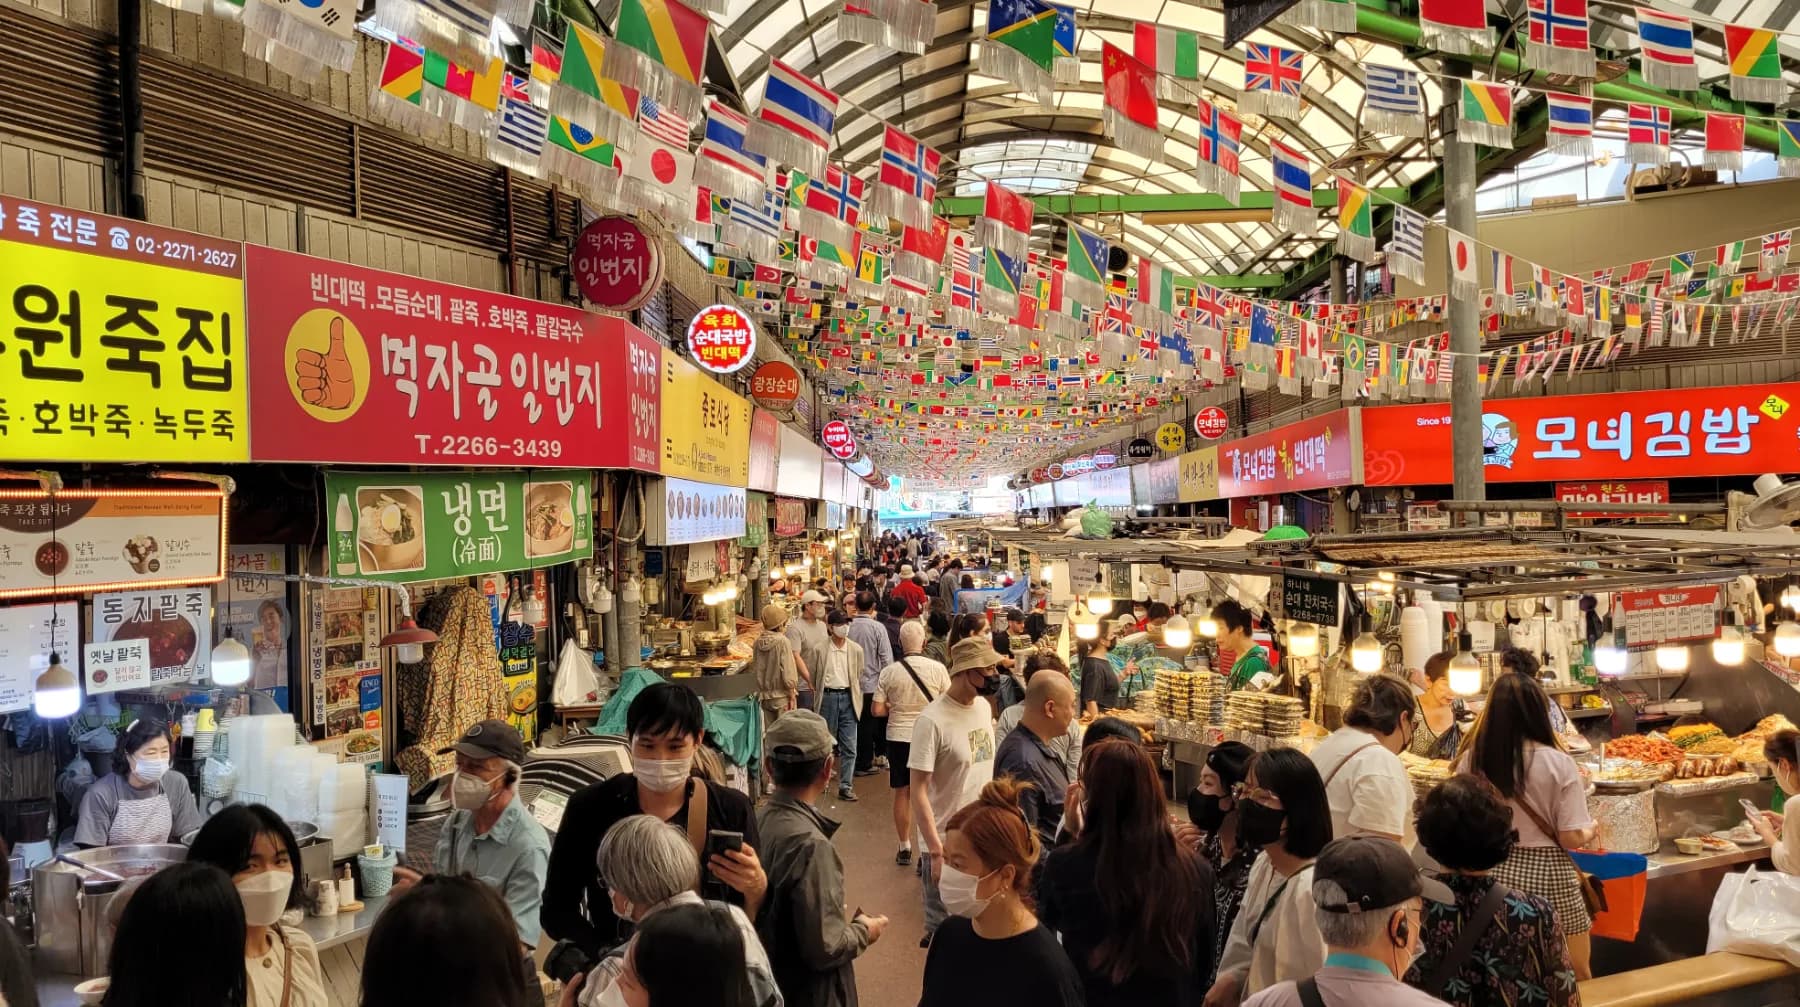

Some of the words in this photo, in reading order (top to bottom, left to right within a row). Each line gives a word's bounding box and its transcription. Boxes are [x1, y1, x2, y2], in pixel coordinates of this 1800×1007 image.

[16, 205, 41, 237] 죽
[50, 212, 98, 247] 전문
[587, 231, 638, 252] 먹자골
[578, 256, 643, 287] 일번지
[702, 313, 738, 327] 육회
[0, 283, 233, 393] 원죽집
[695, 328, 747, 346] 순대국밥
[701, 345, 741, 361] 빈대떡
[630, 340, 657, 394] 먹자골
[754, 376, 798, 394] 광장순대
[631, 392, 657, 442] 일번지
[702, 392, 729, 437] 종로식당
[1199, 418, 1228, 428] 모녀김밥
[1416, 417, 1440, 426] Since
[1533, 405, 1761, 462] 모녀김밥
[1243, 444, 1276, 482] 모녀김밥
[1294, 434, 1325, 475] 빈대떡
[15, 503, 36, 516] 포장
[40, 503, 72, 517] 됩니다
[441, 481, 509, 536] 냉면
[452, 534, 502, 567] (冷面)
[1287, 578, 1311, 592] 하니네
[1285, 590, 1302, 607] 순대
[1303, 594, 1336, 613] 잔치국수
[503, 621, 535, 647] 장수
[91, 649, 114, 665] 옛날
[117, 646, 142, 661] 팥죽
